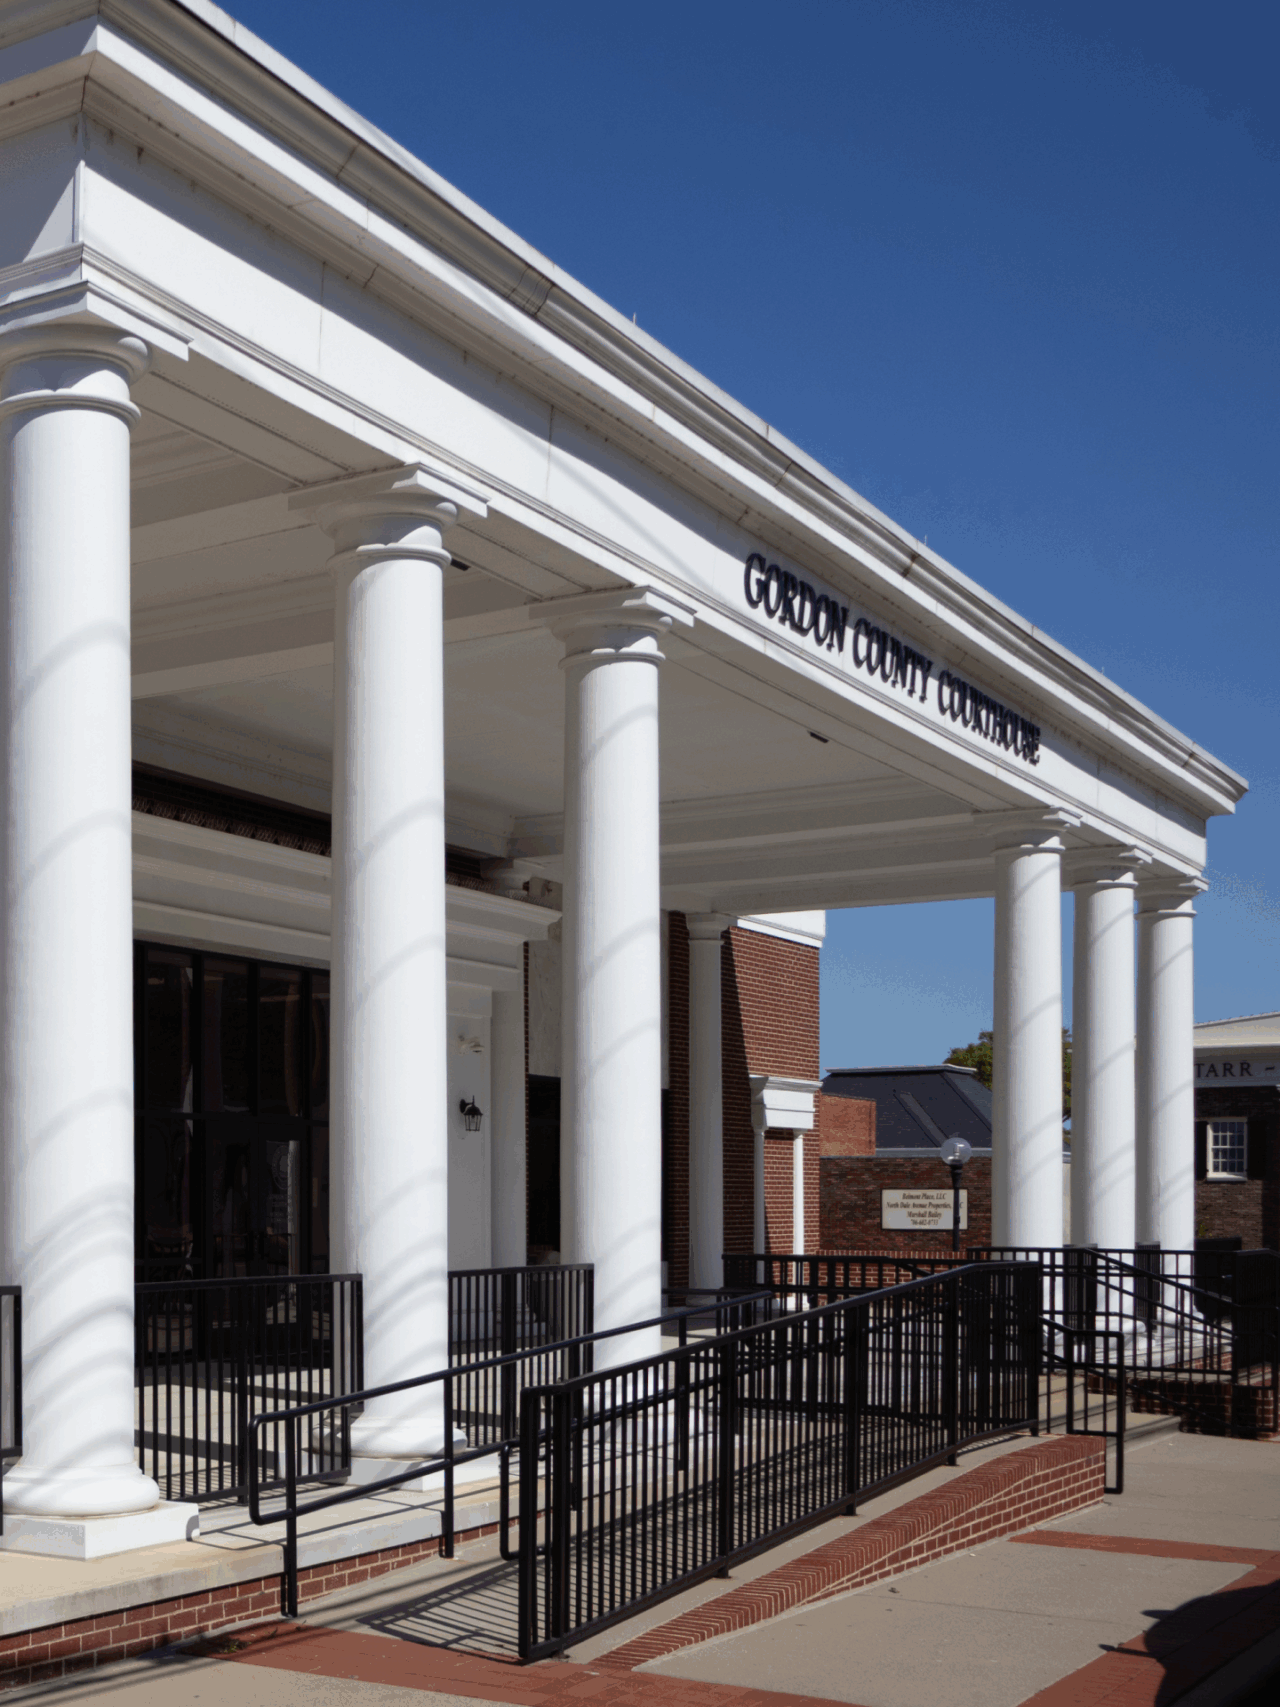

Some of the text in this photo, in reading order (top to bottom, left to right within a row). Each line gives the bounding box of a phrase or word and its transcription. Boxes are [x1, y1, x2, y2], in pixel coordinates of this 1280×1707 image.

[744, 553, 849, 656] GORDON
[853, 618, 933, 703] COUNTY
[936, 1192, 947, 1200] LLC
[886, 1201, 899, 1209] North
[912, 1201, 927, 1209] Avenue
